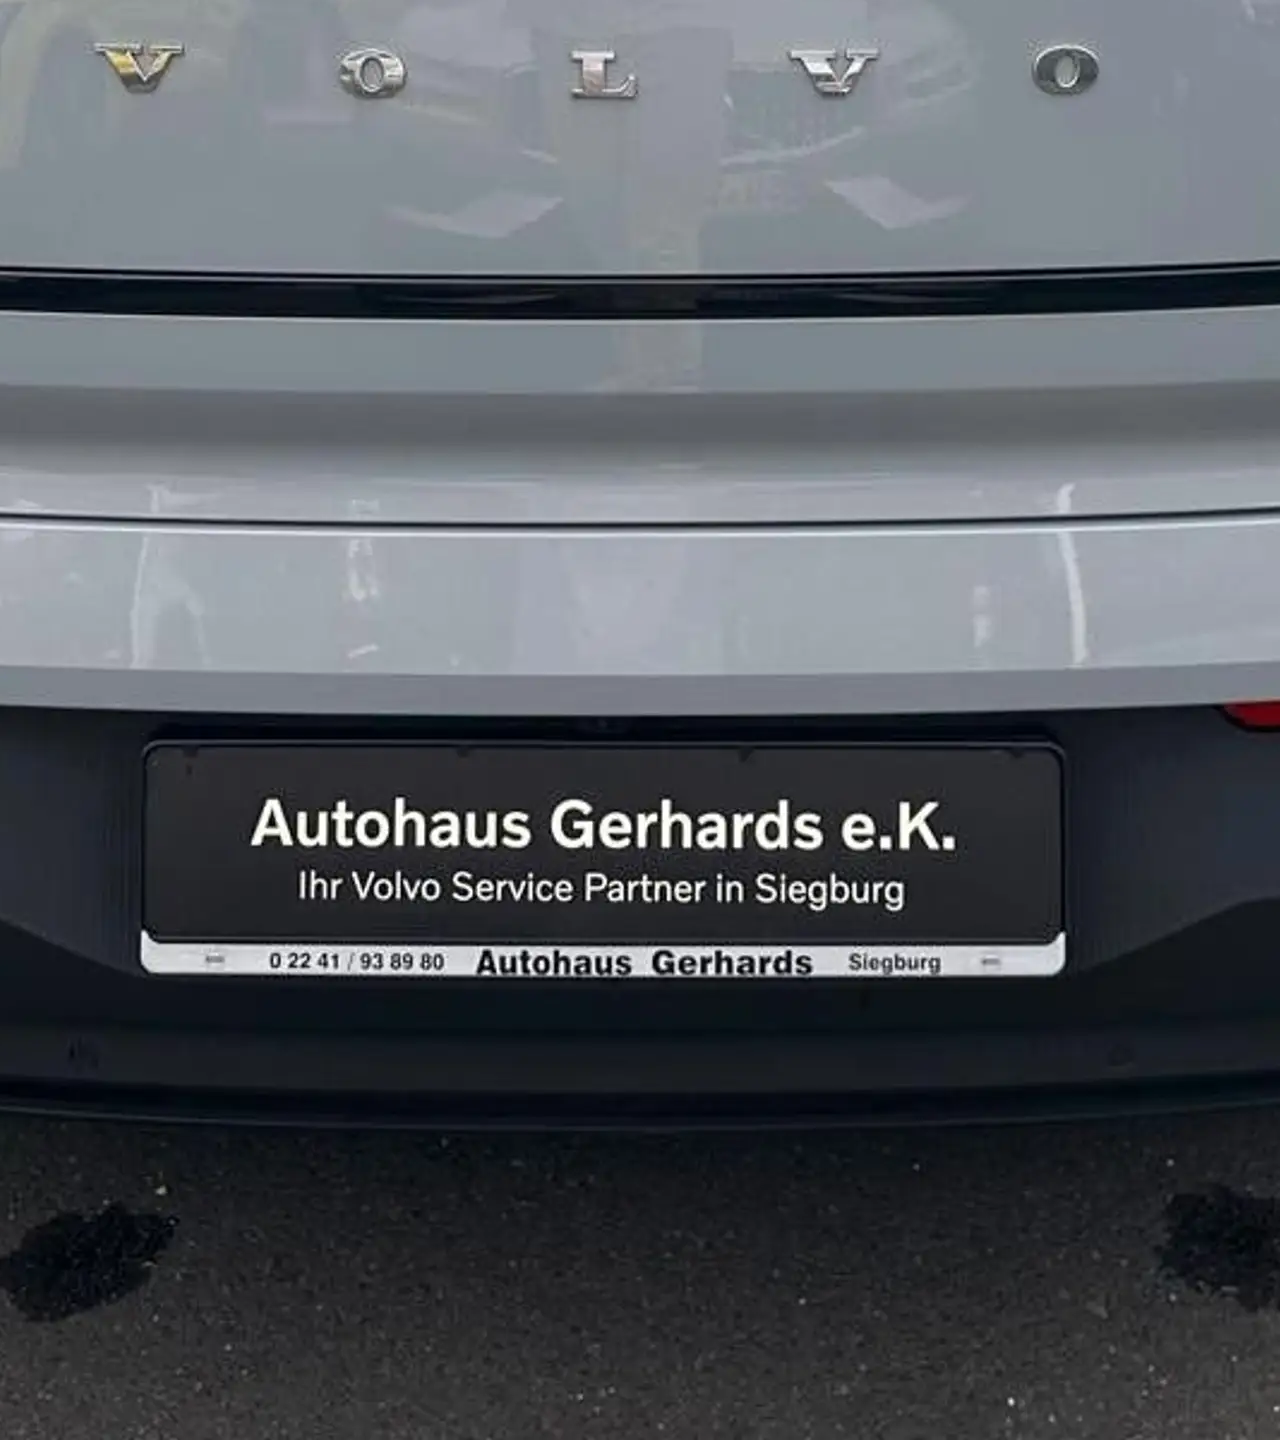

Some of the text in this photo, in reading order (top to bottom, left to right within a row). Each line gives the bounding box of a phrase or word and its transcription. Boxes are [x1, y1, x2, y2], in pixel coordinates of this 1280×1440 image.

[93, 41, 1100, 98] VOLVO
[250, 797, 956, 850] Autohaus Gerhards e.K.
[299, 869, 905, 911] Ihr Volvo Service Partner in Siegburg
[270, 952, 282, 969] 0
[288, 952, 311, 969] 22
[317, 952, 340, 969] 41
[359, 953, 384, 970] 93
[390, 953, 414, 970] 89
[420, 953, 445, 971] 80
[476, 948, 633, 975] Autohaus
[651, 949, 814, 975] Gerhards
[848, 953, 942, 975] Siegburg
